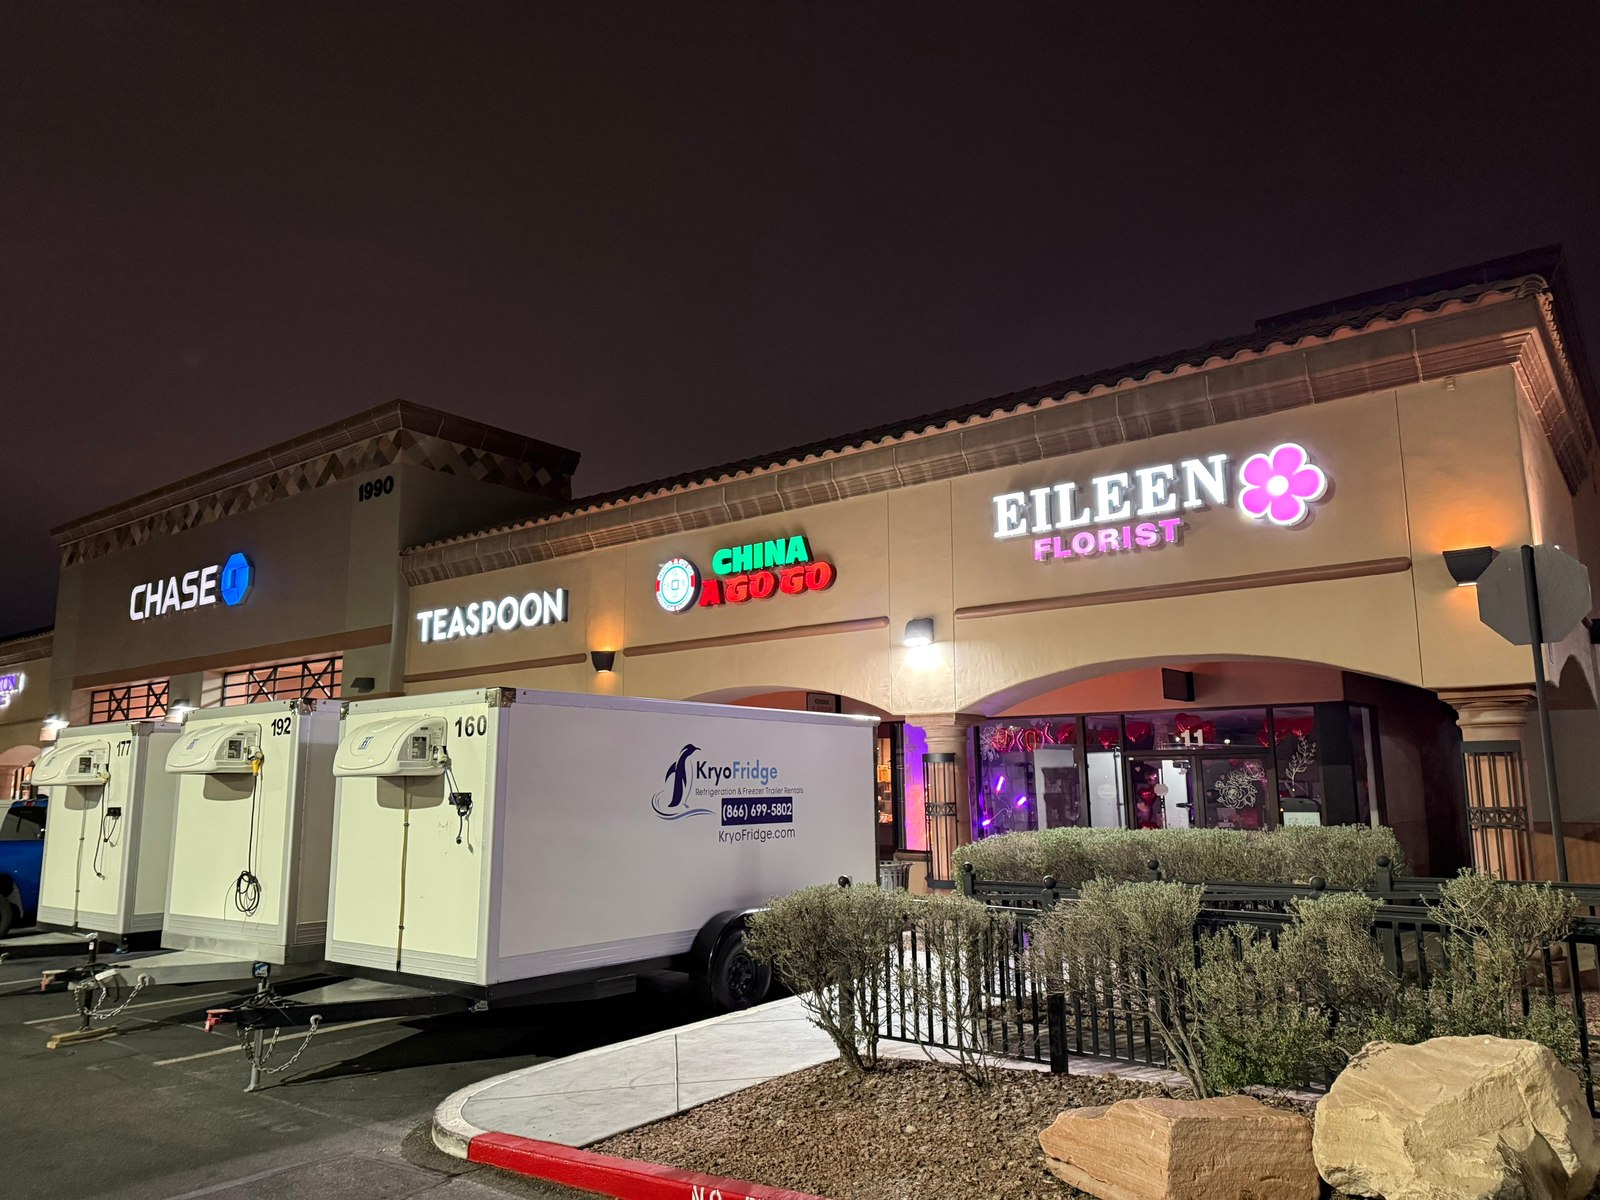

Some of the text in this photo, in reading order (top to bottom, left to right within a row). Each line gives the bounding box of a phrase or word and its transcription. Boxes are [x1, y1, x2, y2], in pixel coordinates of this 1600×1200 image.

[358, 475, 394, 502] 1990
[992, 454, 1229, 538] EILEEN
[1033, 517, 1182, 561] FLORIST
[711, 535, 809, 576] CHINA
[129, 564, 219, 621] CHASE
[698, 579, 722, 607] A
[725, 570, 775, 603] GO
[780, 560, 833, 595] GO
[416, 587, 566, 643] TEASPOON
[270, 716, 292, 737] 192
[454, 714, 487, 738] 160
[1180, 728, 1204, 747] 11
[116, 739, 132, 757] 177
[696, 759, 778, 786] KryoFridge
[695, 787, 737, 797] Refrigeration
[742, 787, 765, 796] Freezer
[765, 786, 783, 795] Trailer
[783, 786, 804, 795] Rentals
[722, 802, 793, 821] (866) 699-5802
[718, 827, 796, 844] KryoFridge.com
